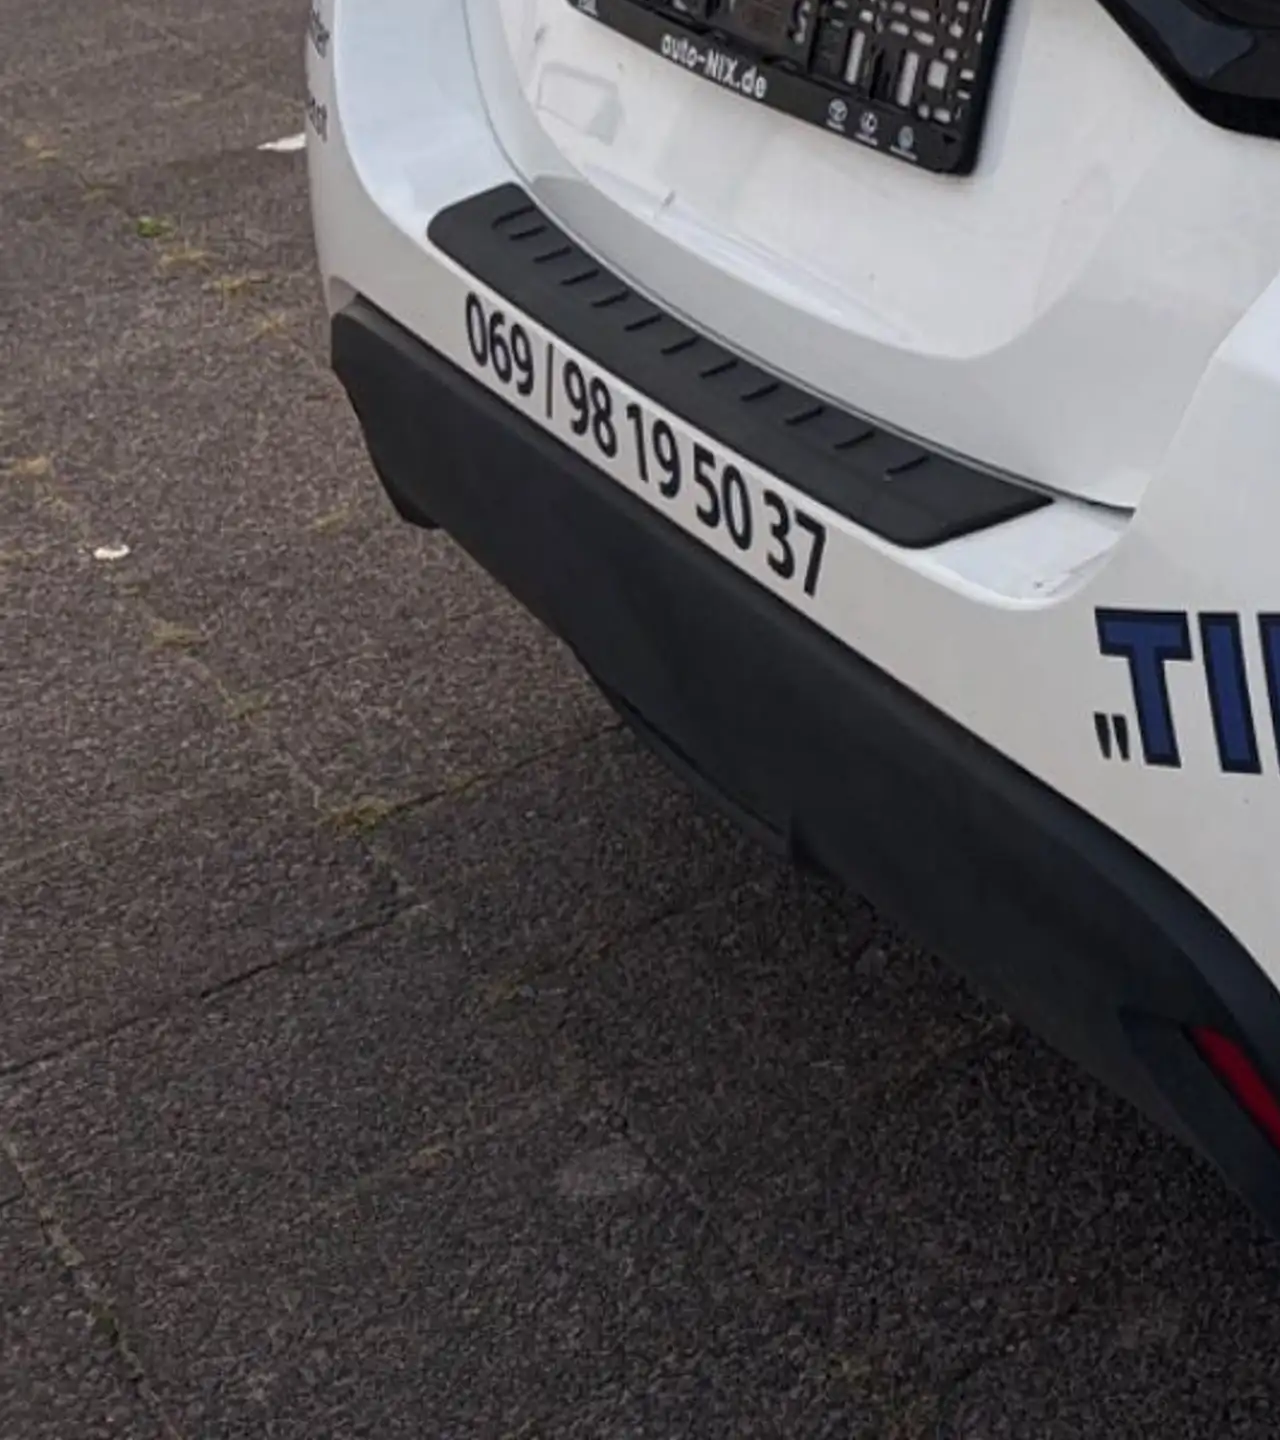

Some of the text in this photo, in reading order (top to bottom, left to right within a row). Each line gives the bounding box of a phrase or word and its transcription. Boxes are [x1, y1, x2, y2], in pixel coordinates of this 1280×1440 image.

[660, 33, 768, 100] auto-NIX.de
[464, 291, 535, 397] 069
[562, 358, 619, 459] 98
[625, 402, 682, 500] 19
[692, 441, 753, 552] 50
[762, 488, 827, 598] 37
